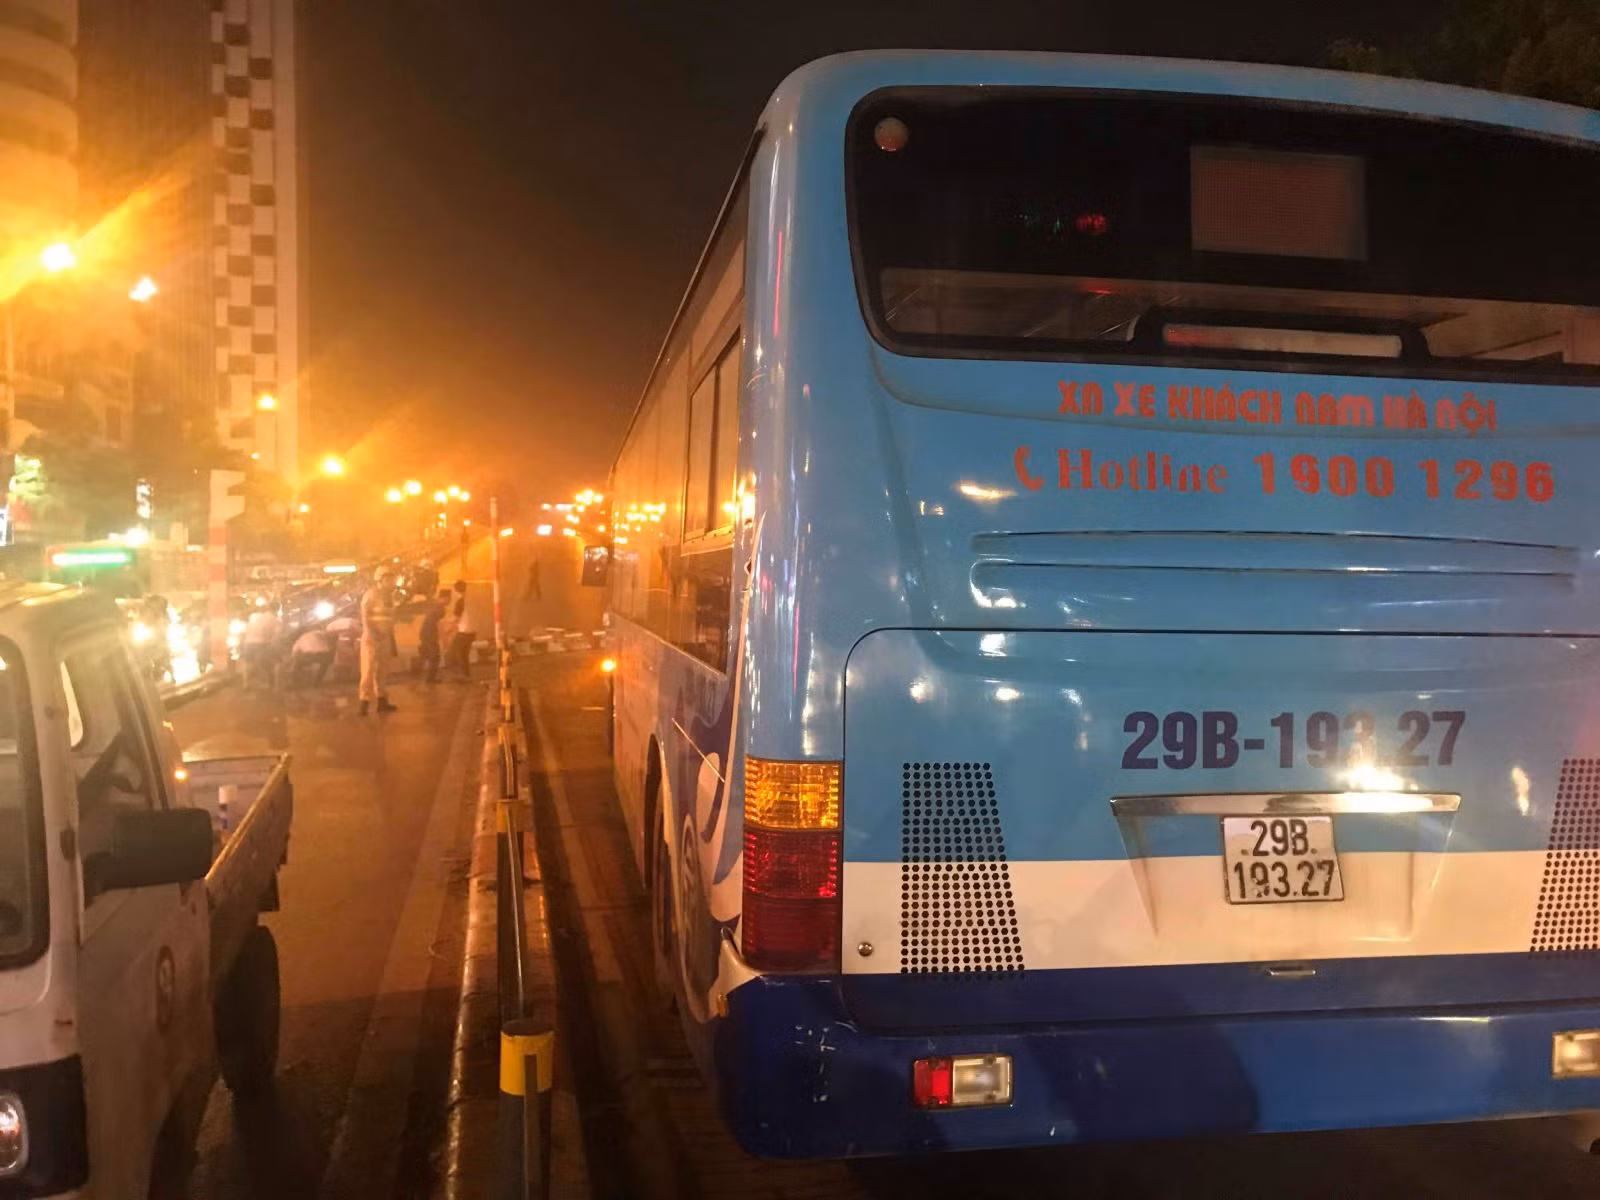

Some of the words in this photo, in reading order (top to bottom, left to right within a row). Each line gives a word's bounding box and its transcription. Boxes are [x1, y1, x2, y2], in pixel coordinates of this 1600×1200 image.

[1114, 381, 1156, 419] XE
[1168, 382, 1282, 424] KHÁCH
[1295, 391, 1375, 426] NAM
[1383, 388, 1427, 429] HÀ
[1436, 391, 1496, 438] NỘI
[1057, 448, 1228, 494] Hotline
[1254, 452, 1394, 497] 1900
[1419, 459, 1555, 502] 1296
[1234, 860, 1334, 899] 193.27
